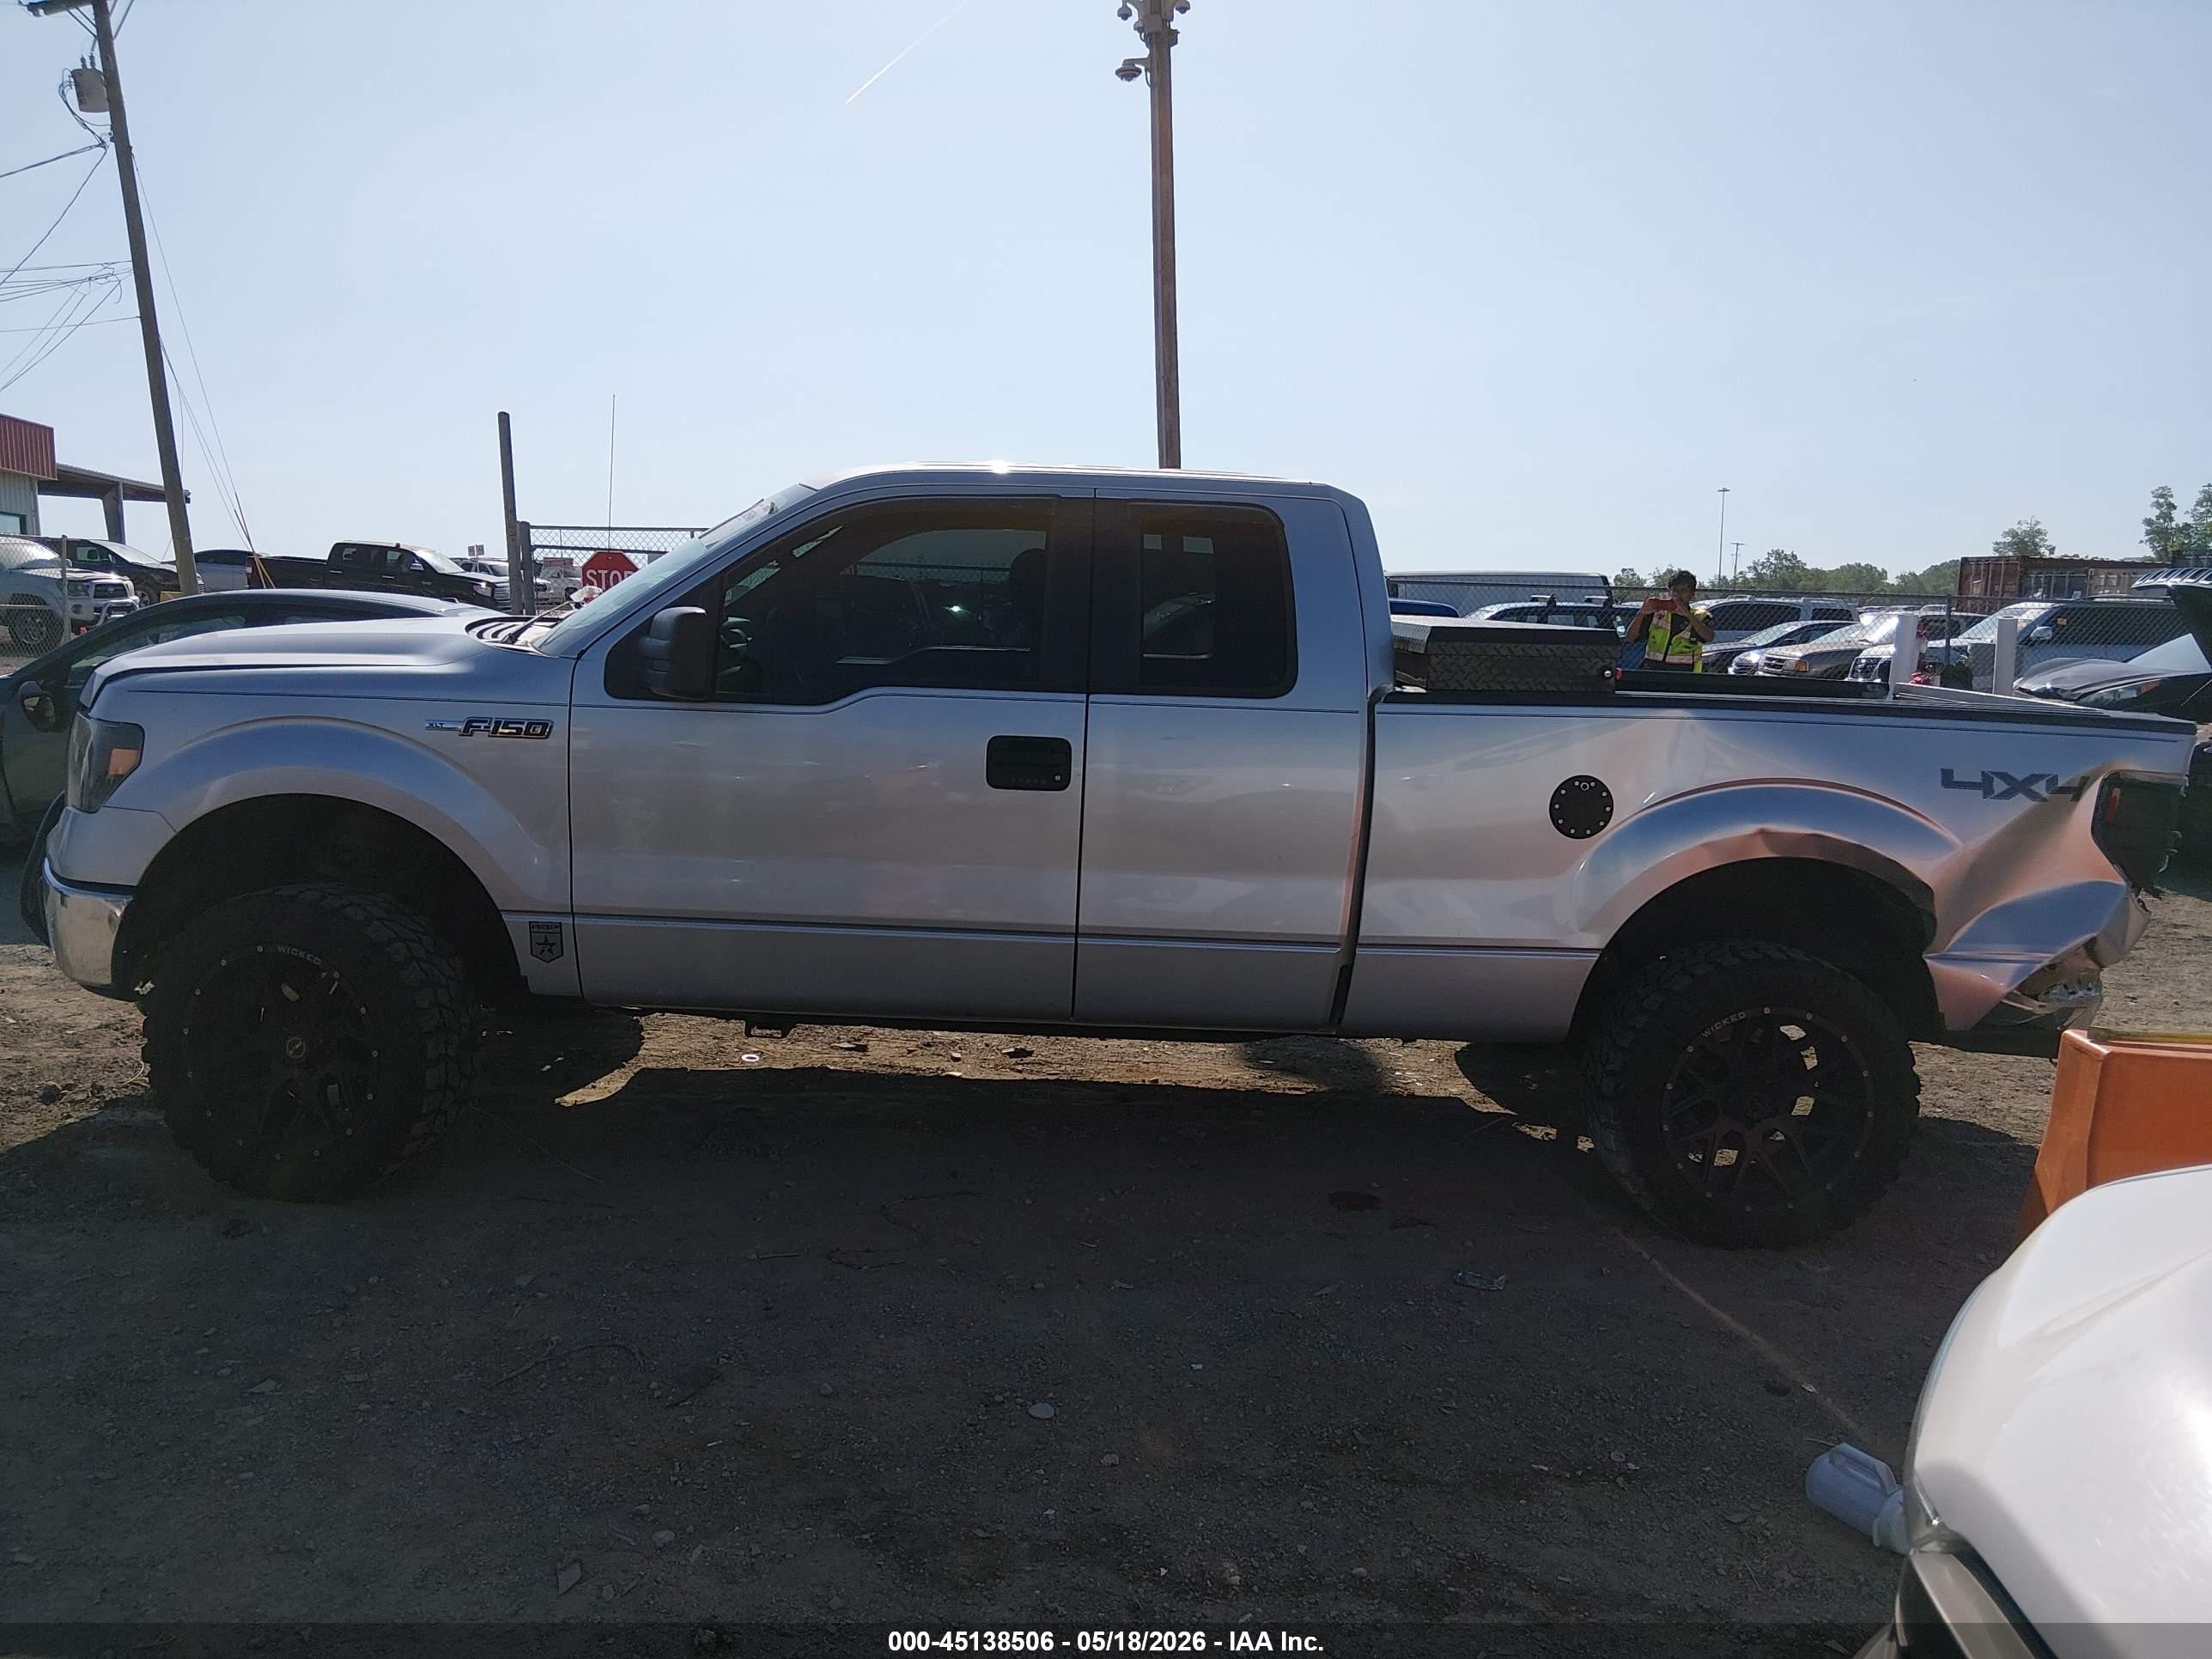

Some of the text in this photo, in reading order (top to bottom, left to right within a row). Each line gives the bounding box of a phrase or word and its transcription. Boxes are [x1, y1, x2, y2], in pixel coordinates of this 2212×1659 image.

[1940, 768, 2090, 803] 4X4
[277, 945, 322, 965] WICKED
[1701, 1012, 1745, 1037] WICKED
